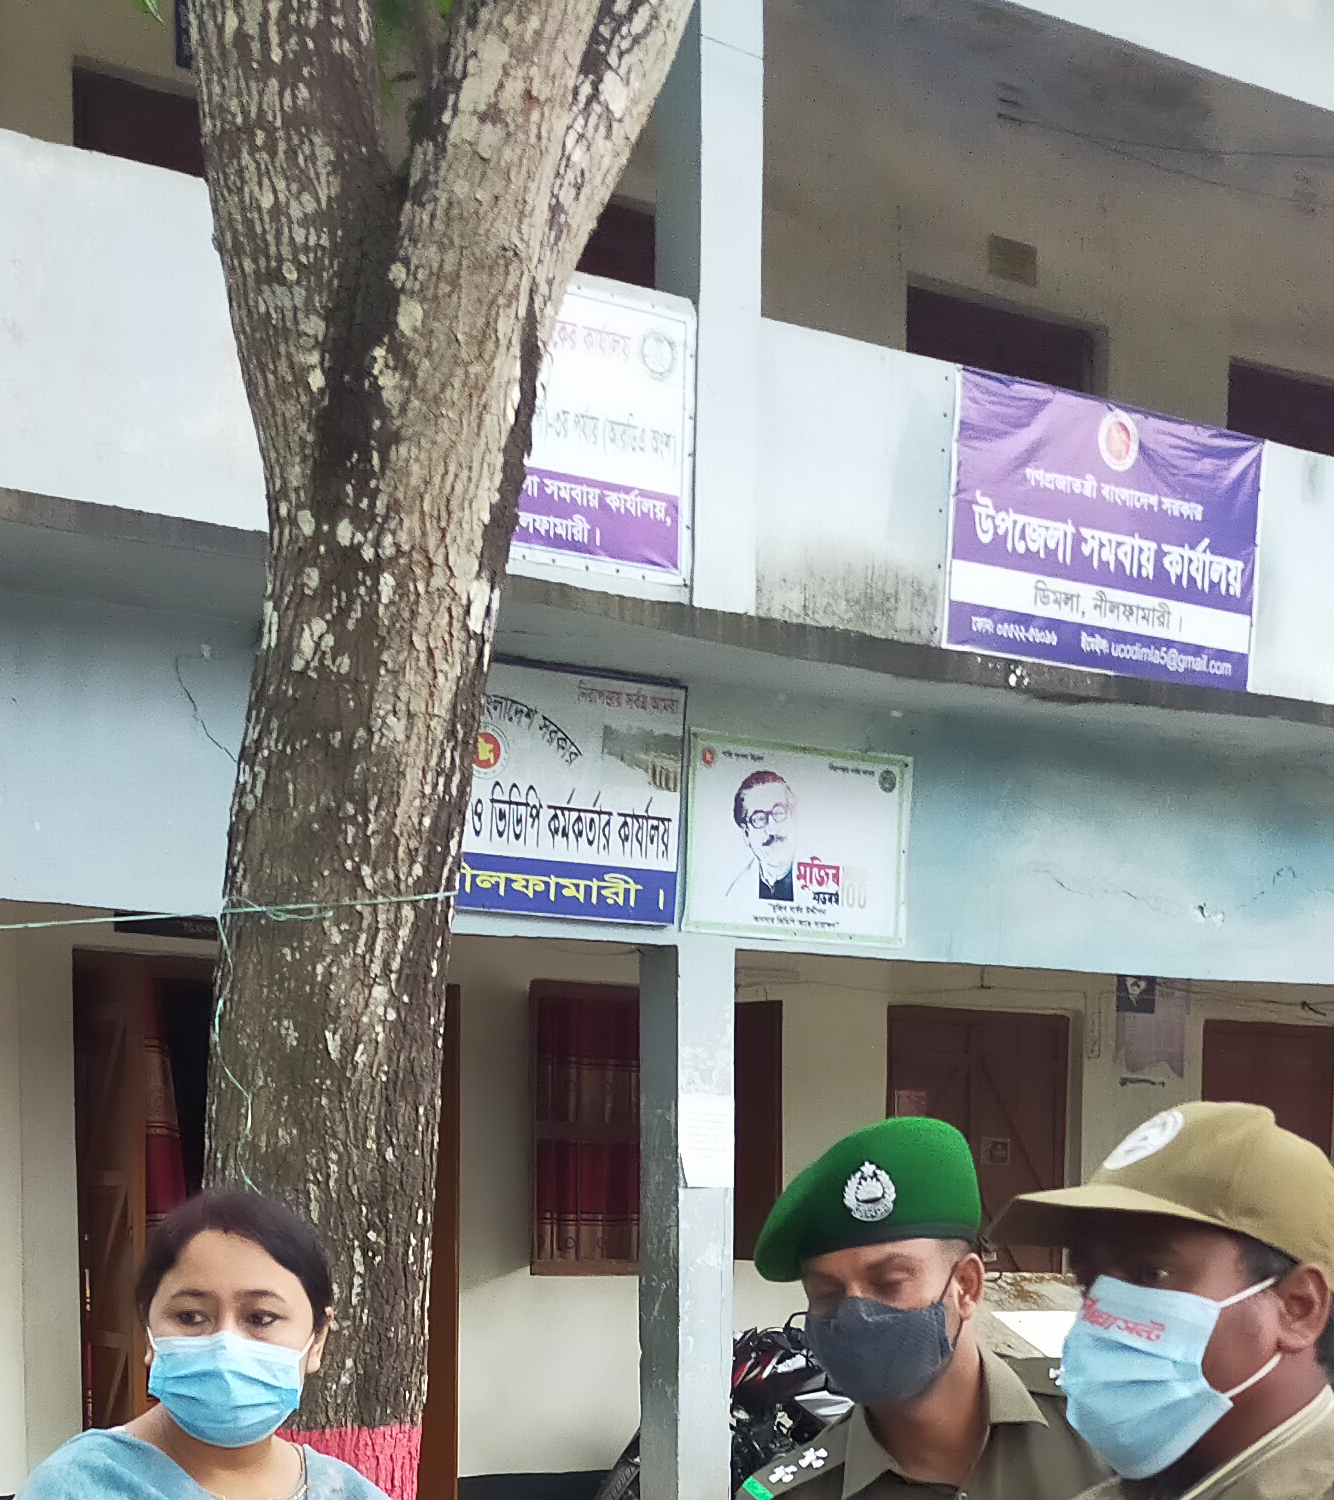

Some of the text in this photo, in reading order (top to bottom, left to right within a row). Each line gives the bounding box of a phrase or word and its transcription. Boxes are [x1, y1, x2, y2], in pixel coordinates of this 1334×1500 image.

[545, 476, 602, 510] সমবায়
[972, 491, 1244, 599] উপজেলা সমবায় কার্যালয়
[1034, 580, 1086, 618] ডিমলা,
[489, 780, 543, 847] ভিডিপি
[547, 788, 613, 856] কর্মকর্তার
[617, 796, 672, 861] কার্যালয়
[796, 856, 840, 890] মুজিব
